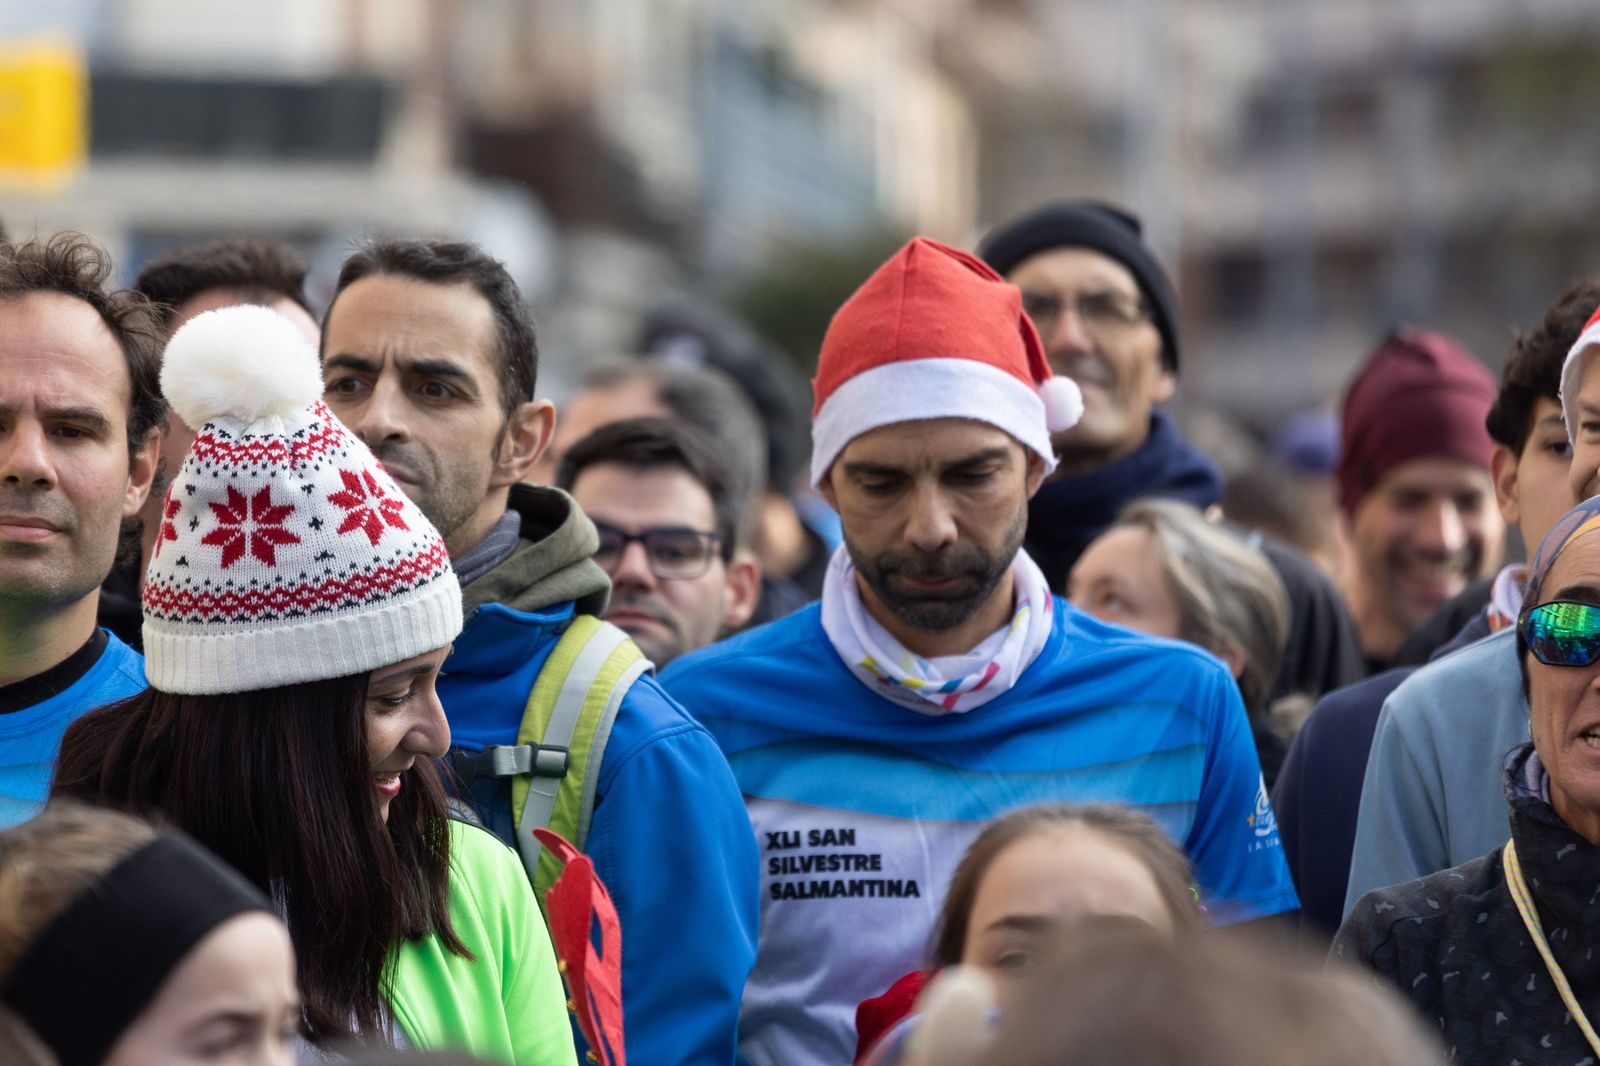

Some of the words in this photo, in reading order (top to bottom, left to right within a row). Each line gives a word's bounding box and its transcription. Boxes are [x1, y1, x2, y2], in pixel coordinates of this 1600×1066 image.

[766, 831, 800, 850] XLI
[808, 829, 855, 847] SAN
[768, 854, 882, 875] SILVESTRE
[770, 880, 920, 900] SALMANTINA
